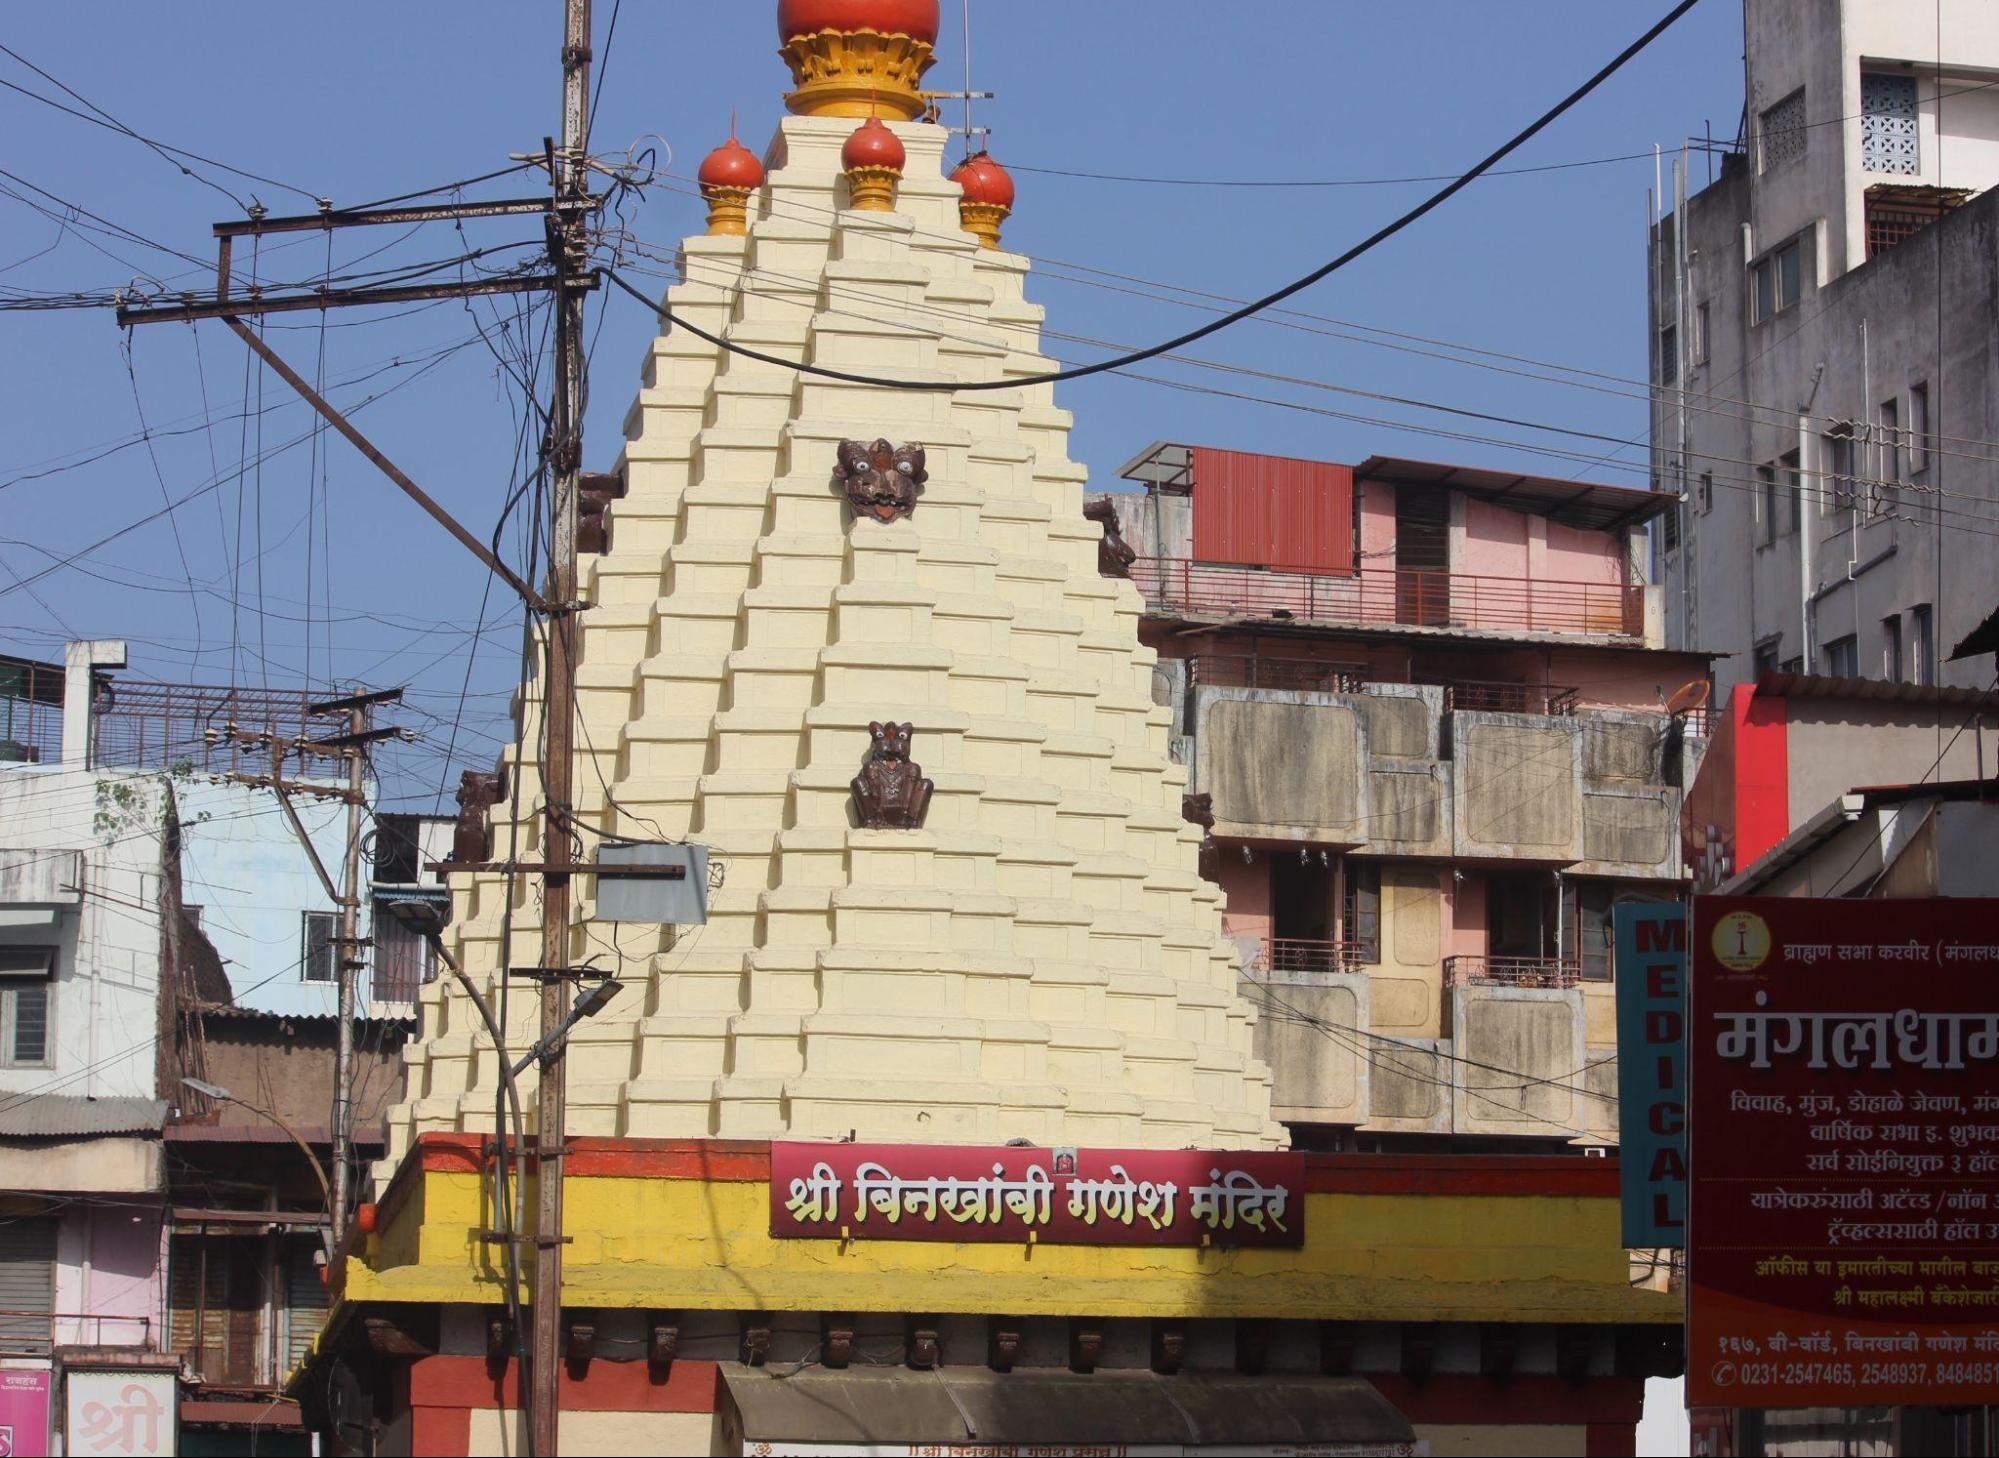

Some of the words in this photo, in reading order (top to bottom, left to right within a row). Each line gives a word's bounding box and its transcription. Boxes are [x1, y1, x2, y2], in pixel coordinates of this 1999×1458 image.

[1784, 944, 1832, 964] ब्राह्मण
[1837, 945, 1872, 959] सभा
[1878, 939, 1930, 960] करवीर
[1636, 920, 1687, 1228] MEDICAL
[1731, 1090, 1792, 1114] विवाह,
[1848, 1090, 1904, 1113] डोहाळे
[1910, 1090, 1966, 1115] जेवण,
[1810, 1120, 1872, 1140] वार्षिक
[1880, 1125, 1919, 1140] सभा
[1807, 1150, 1839, 1170] सर्व
[1952, 1155, 1960, 1173] ३
[785, 1162, 841, 1221] श्री
[853, 1162, 1054, 1224] बिनखांबी
[1066, 1165, 1177, 1229] गणेश
[1189, 1168, 1287, 1236] मंदिर
[1944, 1218, 1980, 1240] हॉल
[1814, 1261, 1831, 1274] या
[1837, 1256, 1913, 1279] इमारतीच्या
[1919, 1256, 1966, 1275] मागील
[1834, 1286, 1852, 1304] श्री
[1925, 1331, 1967, 1352] गणेश
[1741, 1363, 1855, 1387] 0231-2547465,
[78, 1384, 165, 1455] श्री
